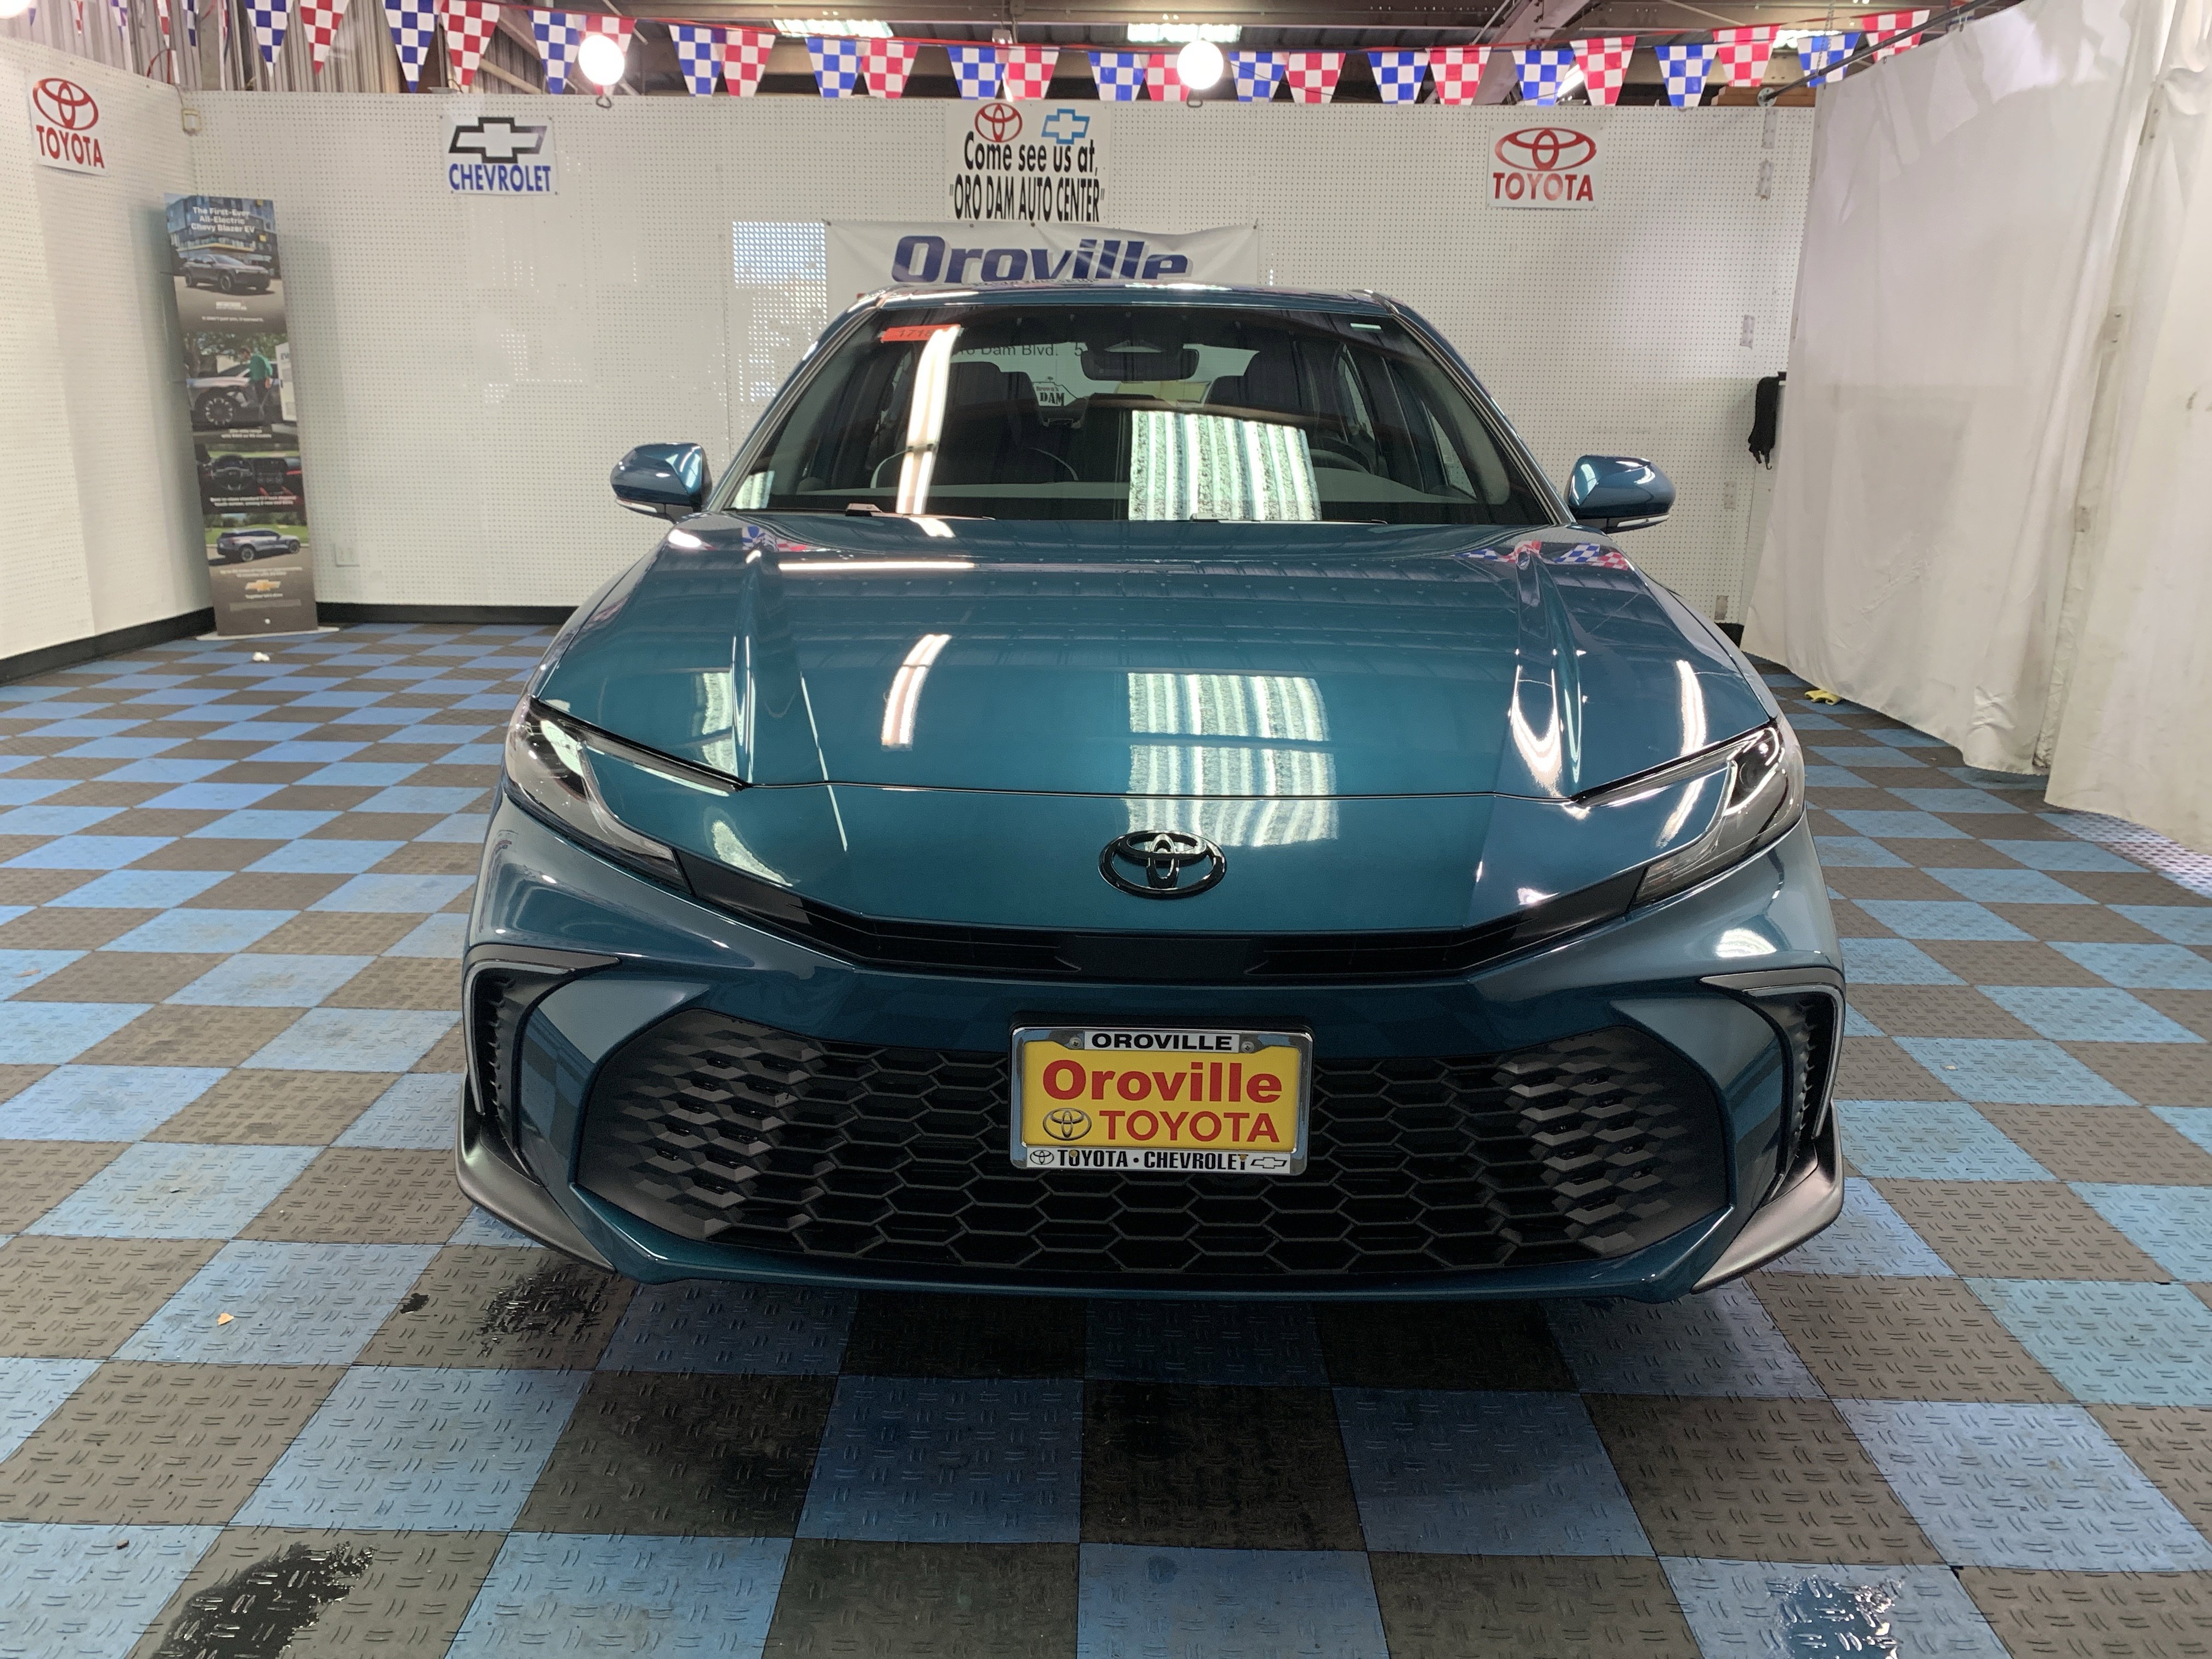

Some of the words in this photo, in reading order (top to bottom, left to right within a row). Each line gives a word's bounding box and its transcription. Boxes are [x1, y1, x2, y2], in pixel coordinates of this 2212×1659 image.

[36, 125, 105, 169] TOYOTA
[964, 131, 1012, 171] Come
[1018, 144, 1047, 172] see
[1053, 145, 1071, 173] us
[1077, 139, 1098, 177] at,
[449, 163, 551, 192] CHEVROLET
[1493, 172, 1594, 201] TOYOTA
[193, 206, 208, 215] The
[209, 207, 251, 217] First-Ever
[986, 175, 1014, 220] DAM
[1018, 176, 1053, 222] AUTO
[191, 222, 216, 233] Chevy
[217, 224, 243, 233] Blazer
[244, 225, 255, 233] EV
[199, 215, 245, 224] All-Electric
[890, 235, 1193, 284] Oroville
[1022, 343, 1058, 356] Blvd.
[1040, 392, 1065, 407] DAM
[1091, 1032, 1233, 1051] OROVILLE
[1042, 1059, 1282, 1103] Oroville
[1099, 1109, 1280, 1143] TOYOTA
[1057, 1149, 1128, 1167] TOYOTA
[1143, 1150, 1249, 1171] CHEVROLET
